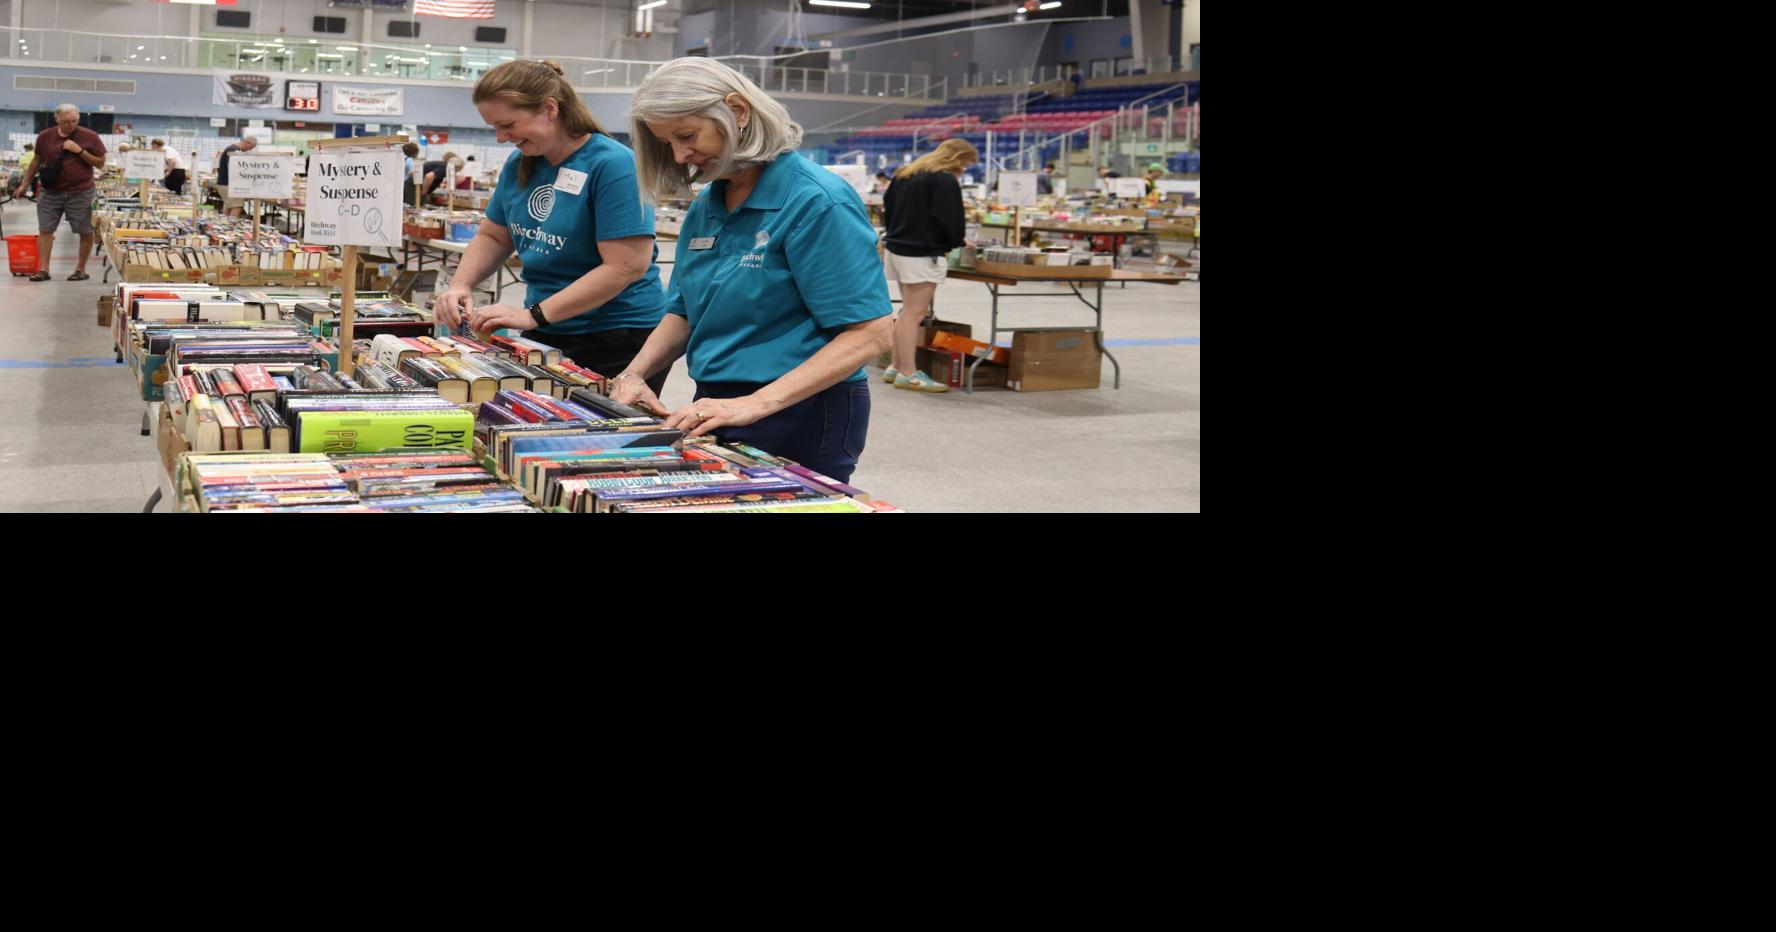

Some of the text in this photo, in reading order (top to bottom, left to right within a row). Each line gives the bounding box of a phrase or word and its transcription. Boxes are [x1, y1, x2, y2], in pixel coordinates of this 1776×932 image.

[294, 98, 318, 110] 30
[238, 160, 280, 171] Mystery &
[319, 161, 382, 181] Mystery &
[239, 172, 279, 181] Suspense
[320, 184, 378, 203] Suspense
[510, 222, 567, 250] Birchway
[435, 430, 466, 448] PA
